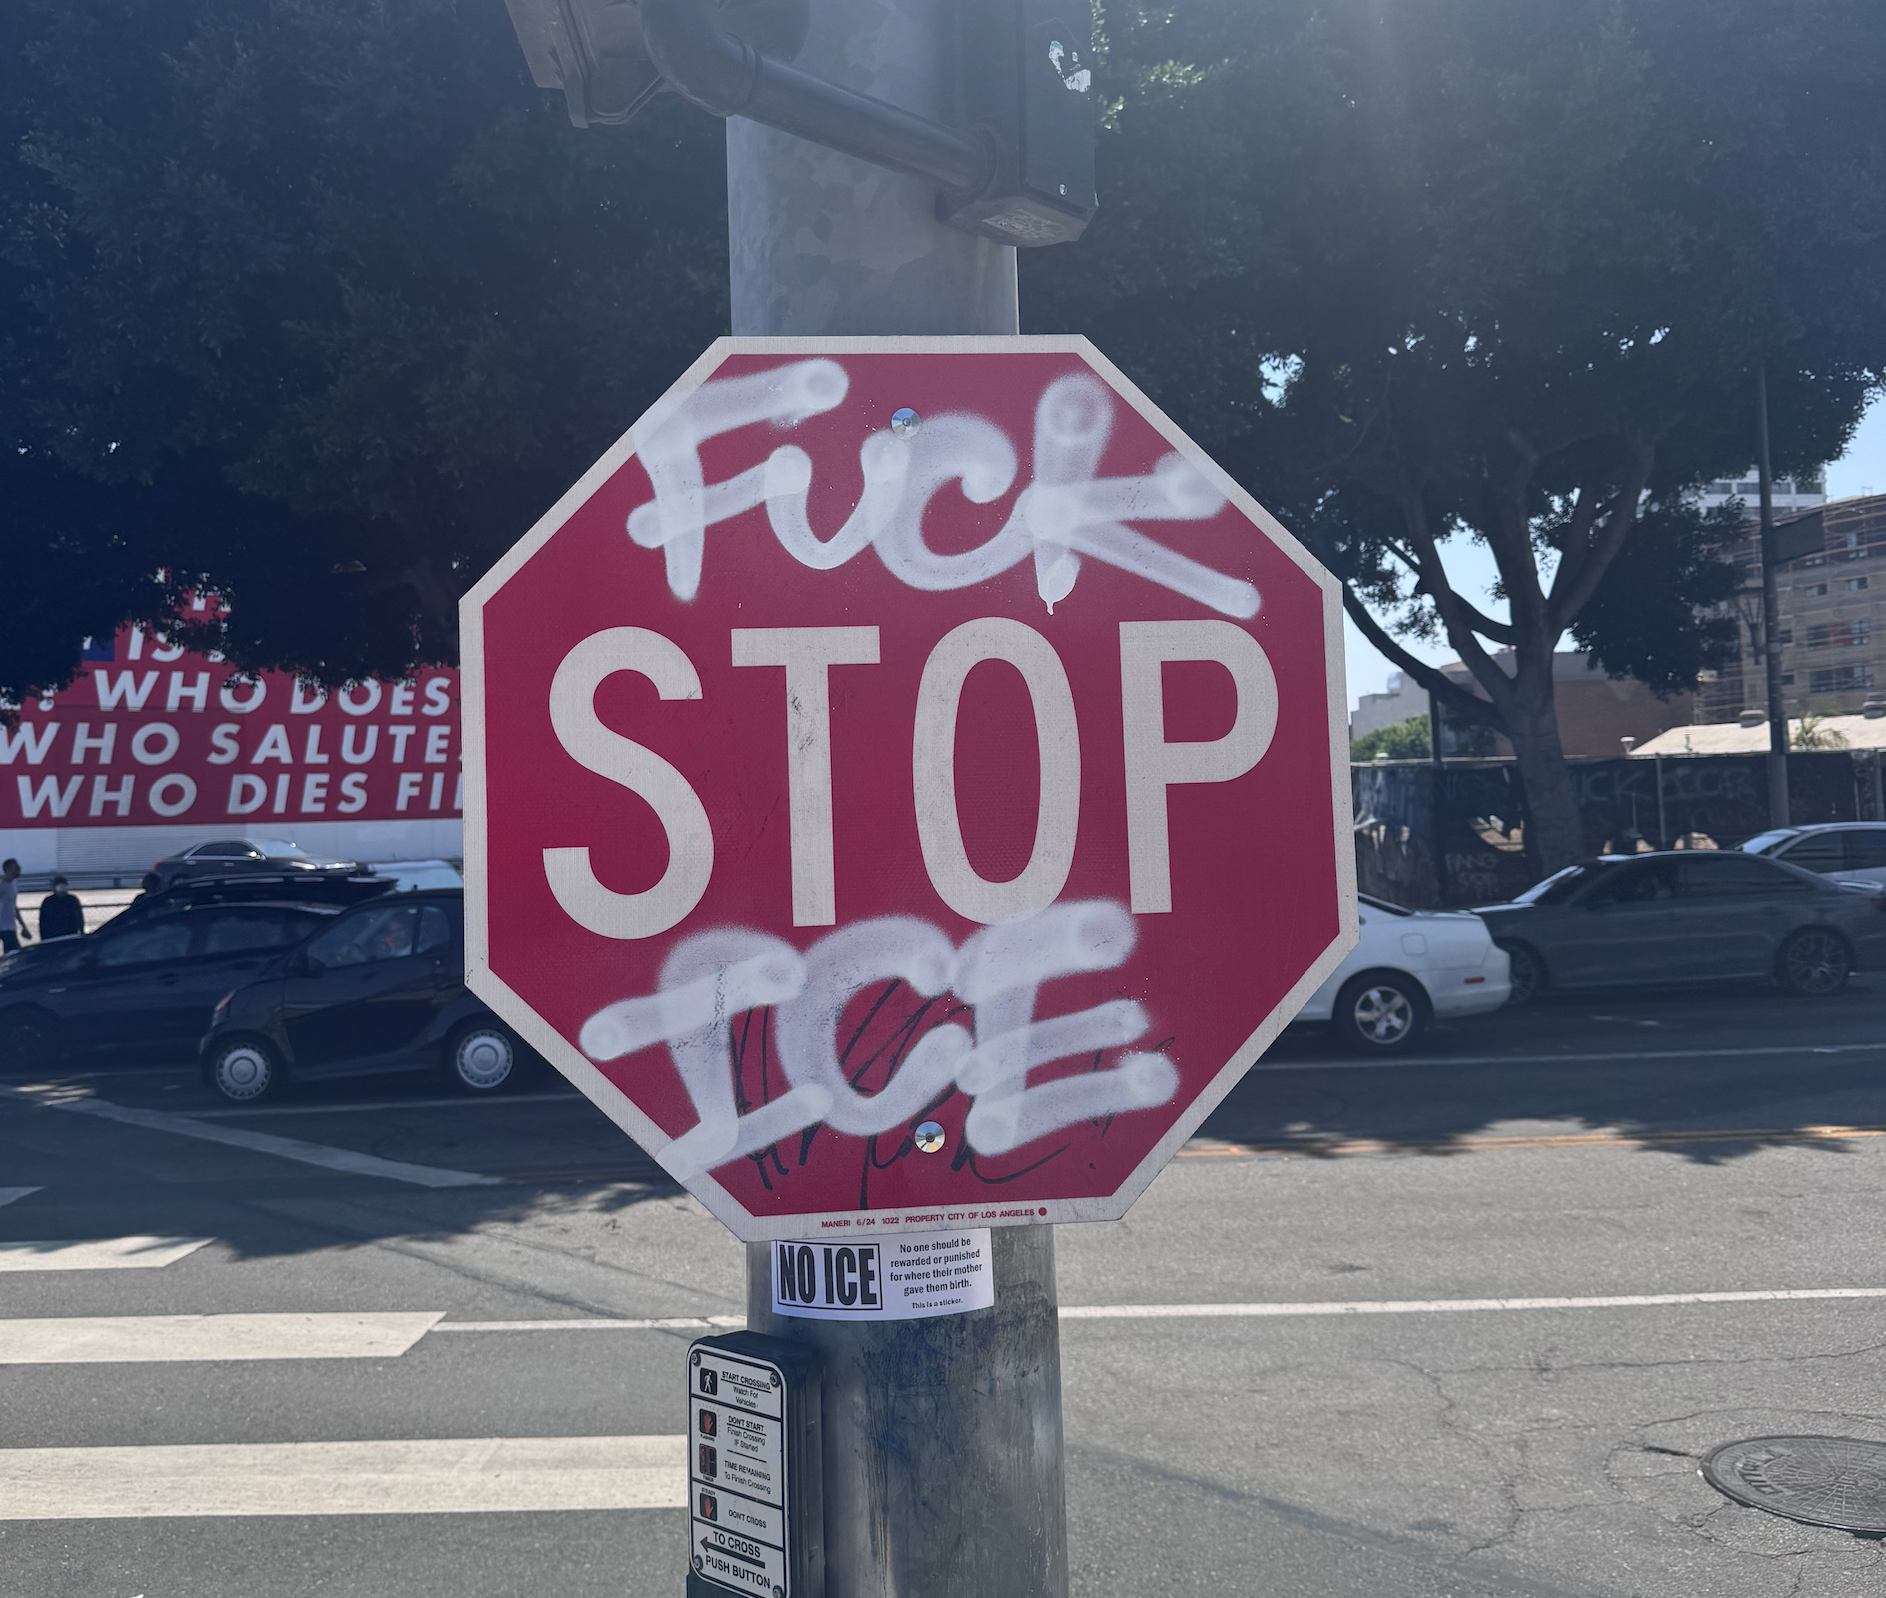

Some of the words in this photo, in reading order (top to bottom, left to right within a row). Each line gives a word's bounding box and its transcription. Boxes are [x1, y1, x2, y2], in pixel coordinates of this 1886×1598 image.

[94, 669, 267, 714] WHO
[290, 673, 451, 716] DOES
[0, 721, 180, 765] WHO
[207, 722, 462, 765] SALUTE
[543, 617, 1279, 939] STOP
[17, 772, 197, 818] WHO
[227, 772, 369, 815] DIES
[579, 898, 1180, 1183] ICE
[821, 1219, 851, 1229] MANERI
[881, 1216, 900, 1225] 1022
[905, 1213, 945, 1224] PROPERTY
[947, 1212, 966, 1221] CITY
[968, 1211, 979, 1220] OF
[981, 1210, 997, 1219] LOS
[999, 1208, 1035, 1218] ANGELES
[900, 1244, 912, 1254] No
[913, 1244, 930, 1253] one
[931, 1237, 960, 1251] should
[961, 1237, 972, 1247] be
[890, 1255, 932, 1268] rewarded
[933, 1255, 942, 1265] or
[943, 1248, 981, 1266] punished
[779, 1244, 816, 1304] NO
[823, 1246, 878, 1306] ICE
[890, 1271, 903, 1282] for
[903, 1271, 931, 1281] where
[932, 1267, 953, 1278] their
[954, 1263, 983, 1276] mother
[903, 1286, 924, 1297] gave
[926, 1282, 948, 1293] them
[949, 1278, 972, 1291] birth.
[911, 1301, 926, 1309] This
[722, 1370, 740, 1382] START
[740, 1375, 771, 1390] CROSSING
[727, 1426, 743, 1438] Finish
[742, 1431, 766, 1447] Crossing
[745, 1420, 764, 1432] START
[724, 1460, 738, 1471] TIME
[738, 1464, 771, 1481] REMAINING
[724, 1471, 731, 1480] To
[731, 1473, 747, 1486] Finish
[747, 1478, 771, 1495] Crossing
[746, 1515, 767, 1529] CROSS
[713, 1531, 726, 1545] TO
[728, 1536, 761, 1558] CROSS
[705, 1554, 730, 1574] PUSH
[732, 1564, 771, 1589] BUTTON
